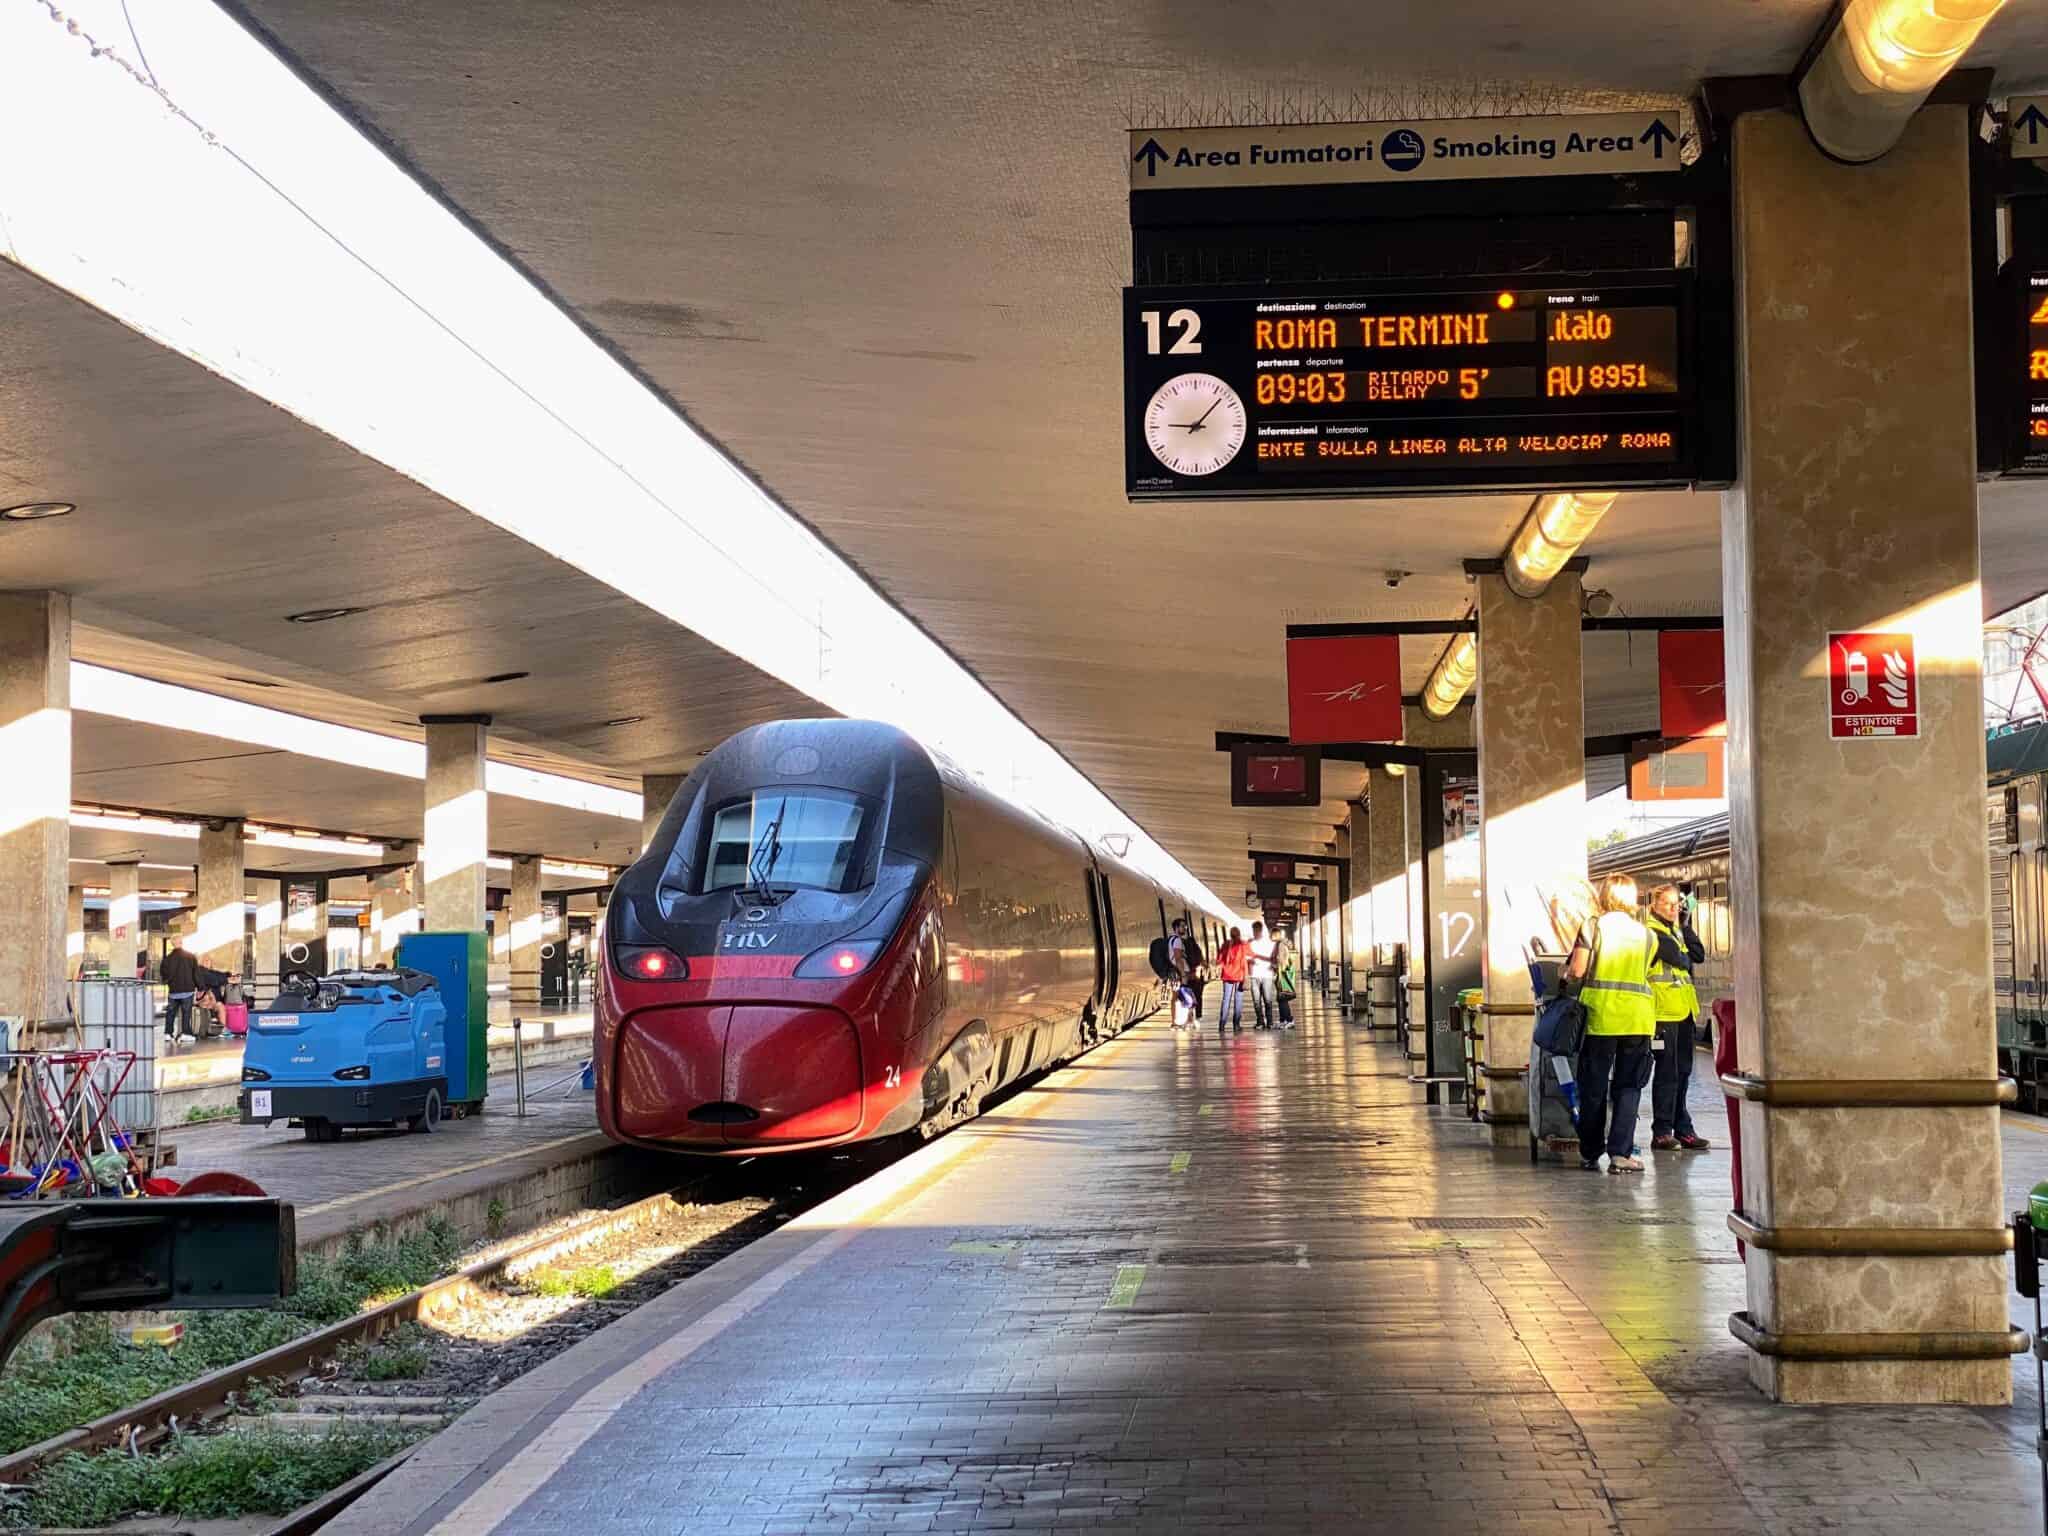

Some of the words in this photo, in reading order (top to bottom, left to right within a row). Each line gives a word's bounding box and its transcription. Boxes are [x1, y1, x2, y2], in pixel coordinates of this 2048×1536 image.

[1174, 147, 1241, 168] Area
[1249, 140, 1374, 165] Fumatori
[1433, 133, 1557, 160] Smoking
[1565, 132, 1634, 154] Area
[1256, 302, 1317, 312] destinazione
[1324, 301, 1367, 311] destination
[1548, 295, 1575, 304] treno
[1141, 308, 1203, 354] 12
[1256, 318, 1337, 350] ROMA
[1359, 313, 1489, 348] TERMINI
[1257, 358, 1300, 369] partenza
[1306, 356, 1344, 368] departure
[1256, 372, 1346, 405] 09:03
[1368, 370, 1449, 386] RITARDO
[1459, 368, 1490, 400] 5'
[1368, 384, 1428, 400] DELAY
[1547, 363, 1583, 397] AV
[1589, 363, 1649, 389] 8951
[1257, 425, 1318, 437] informazioni
[1325, 424, 1369, 435] information
[1258, 441, 1305, 457] ENTE
[1318, 439, 1378, 456] SULLA
[1389, 437, 1447, 455] LINEA
[1458, 436, 1508, 453] ALTA
[1846, 715, 1905, 727] ESTINTORE
[1438, 911, 1475, 960] 12
[885, 1064, 901, 1088] 24
